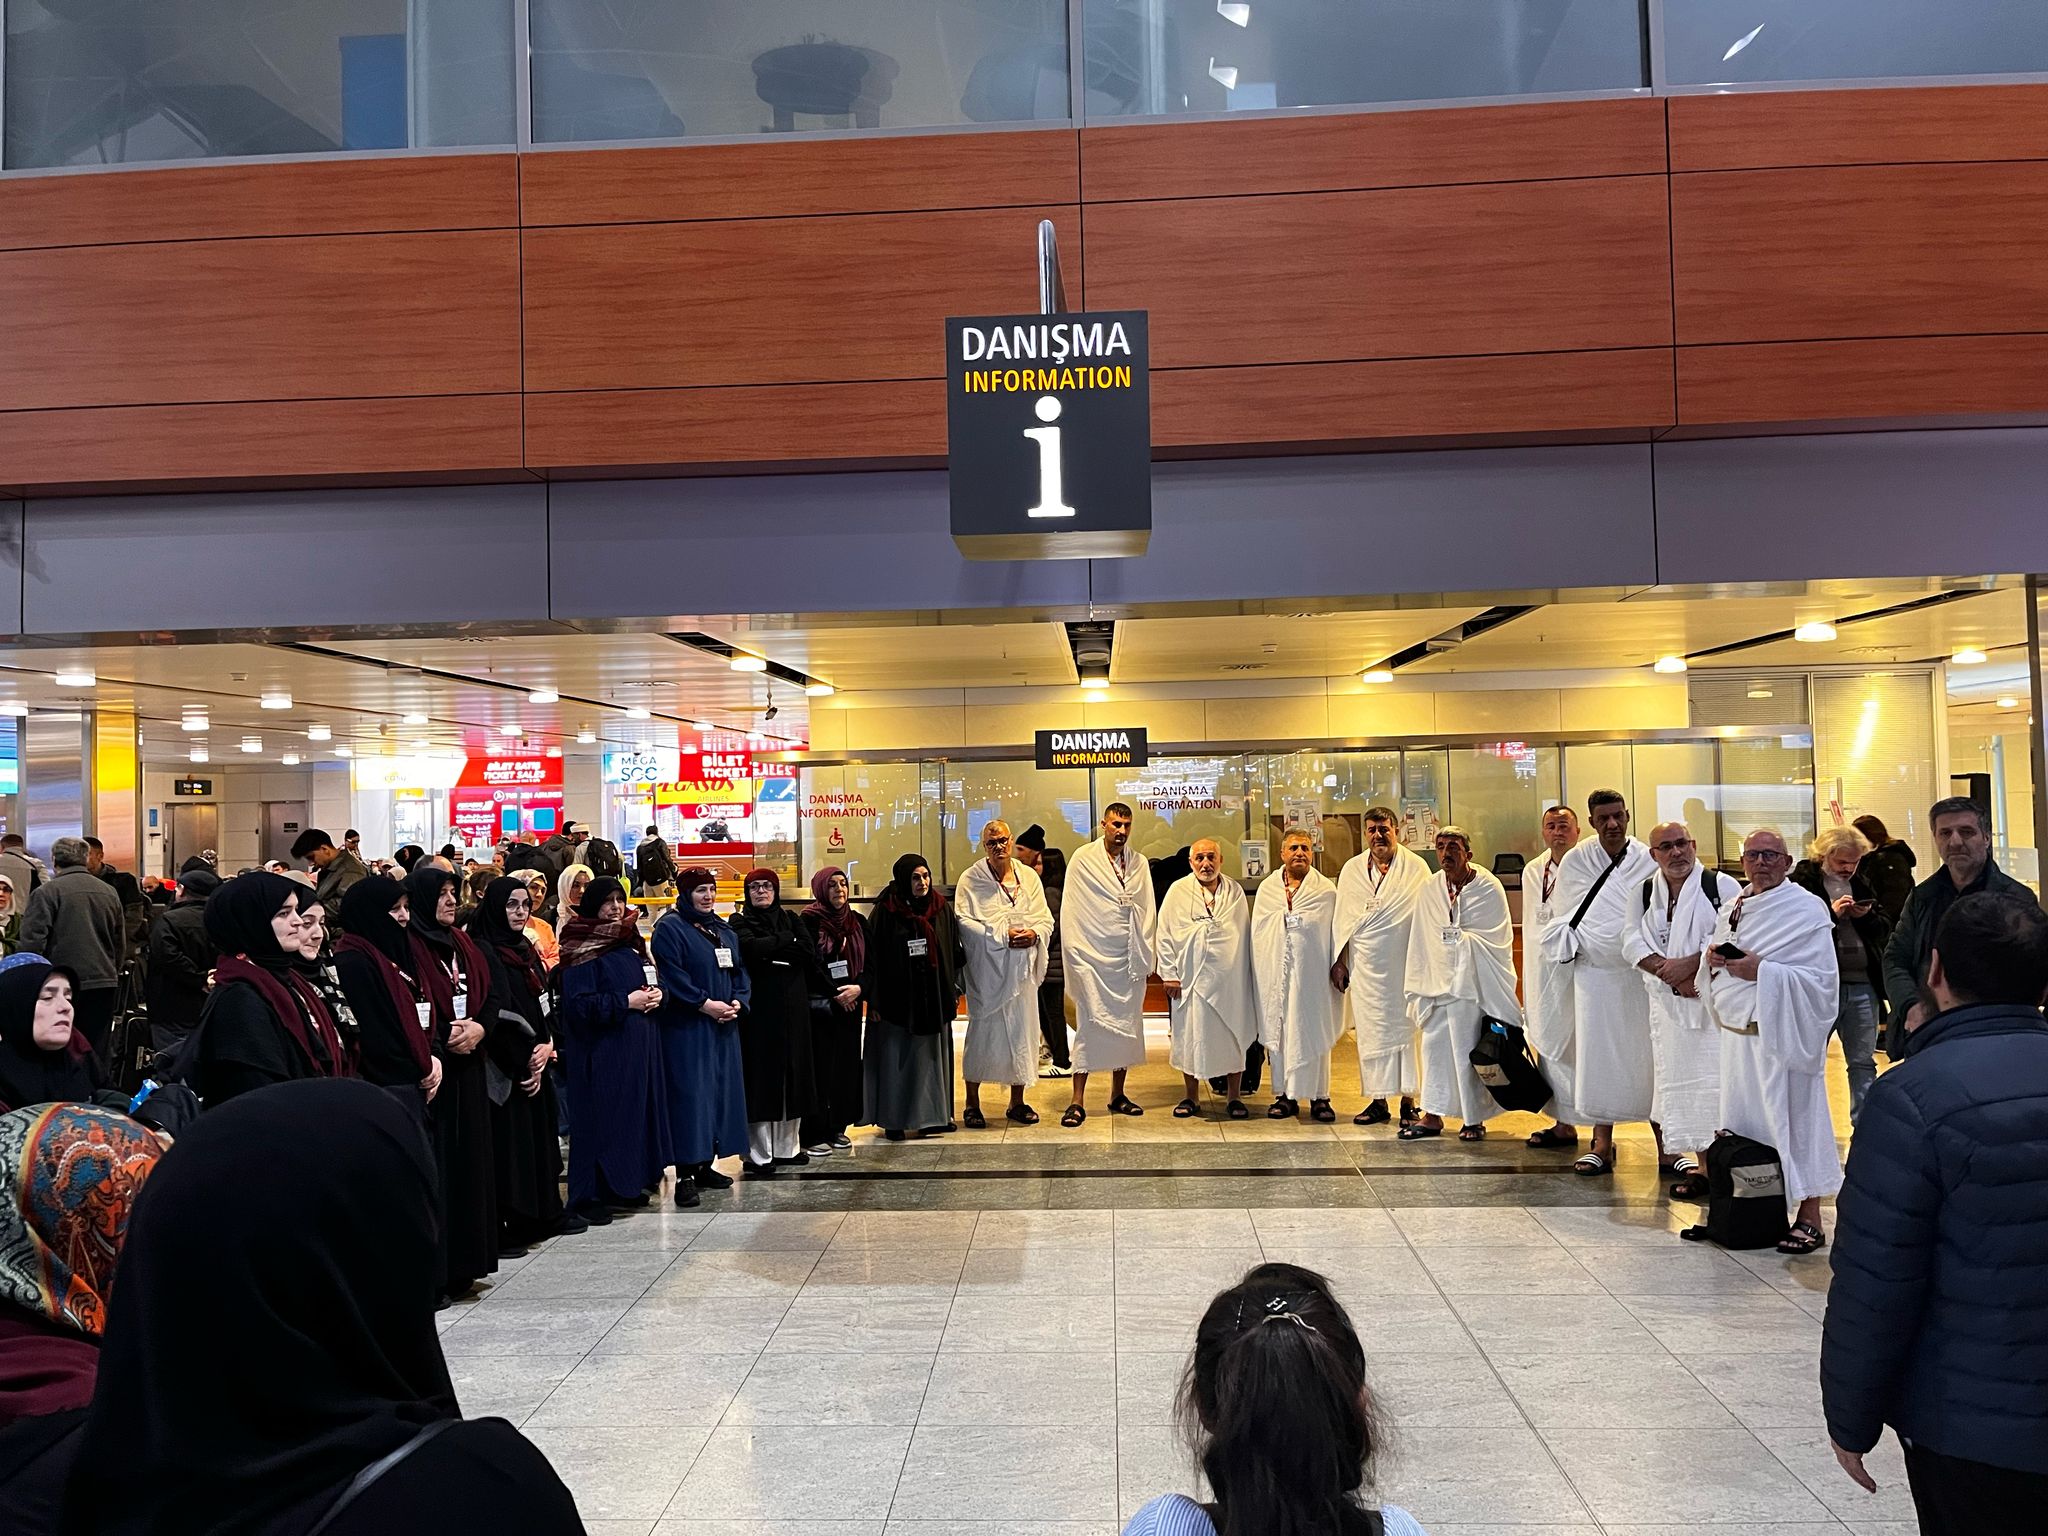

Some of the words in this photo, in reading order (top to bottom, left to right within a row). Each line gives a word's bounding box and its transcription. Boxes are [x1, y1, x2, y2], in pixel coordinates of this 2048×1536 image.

[962, 321, 1131, 364] DANIŞMA
[964, 365, 1132, 393] INFORMATION
[1051, 732, 1130, 752] DANIŞMA
[621, 756, 657, 765] MEGA
[1052, 752, 1130, 765] INFORMATION
[702, 767, 748, 778] TICKET
[809, 794, 864, 806] DANIŞMA
[1139, 799, 1222, 811] INFORMATION
[799, 807, 876, 818] NFORMATION
